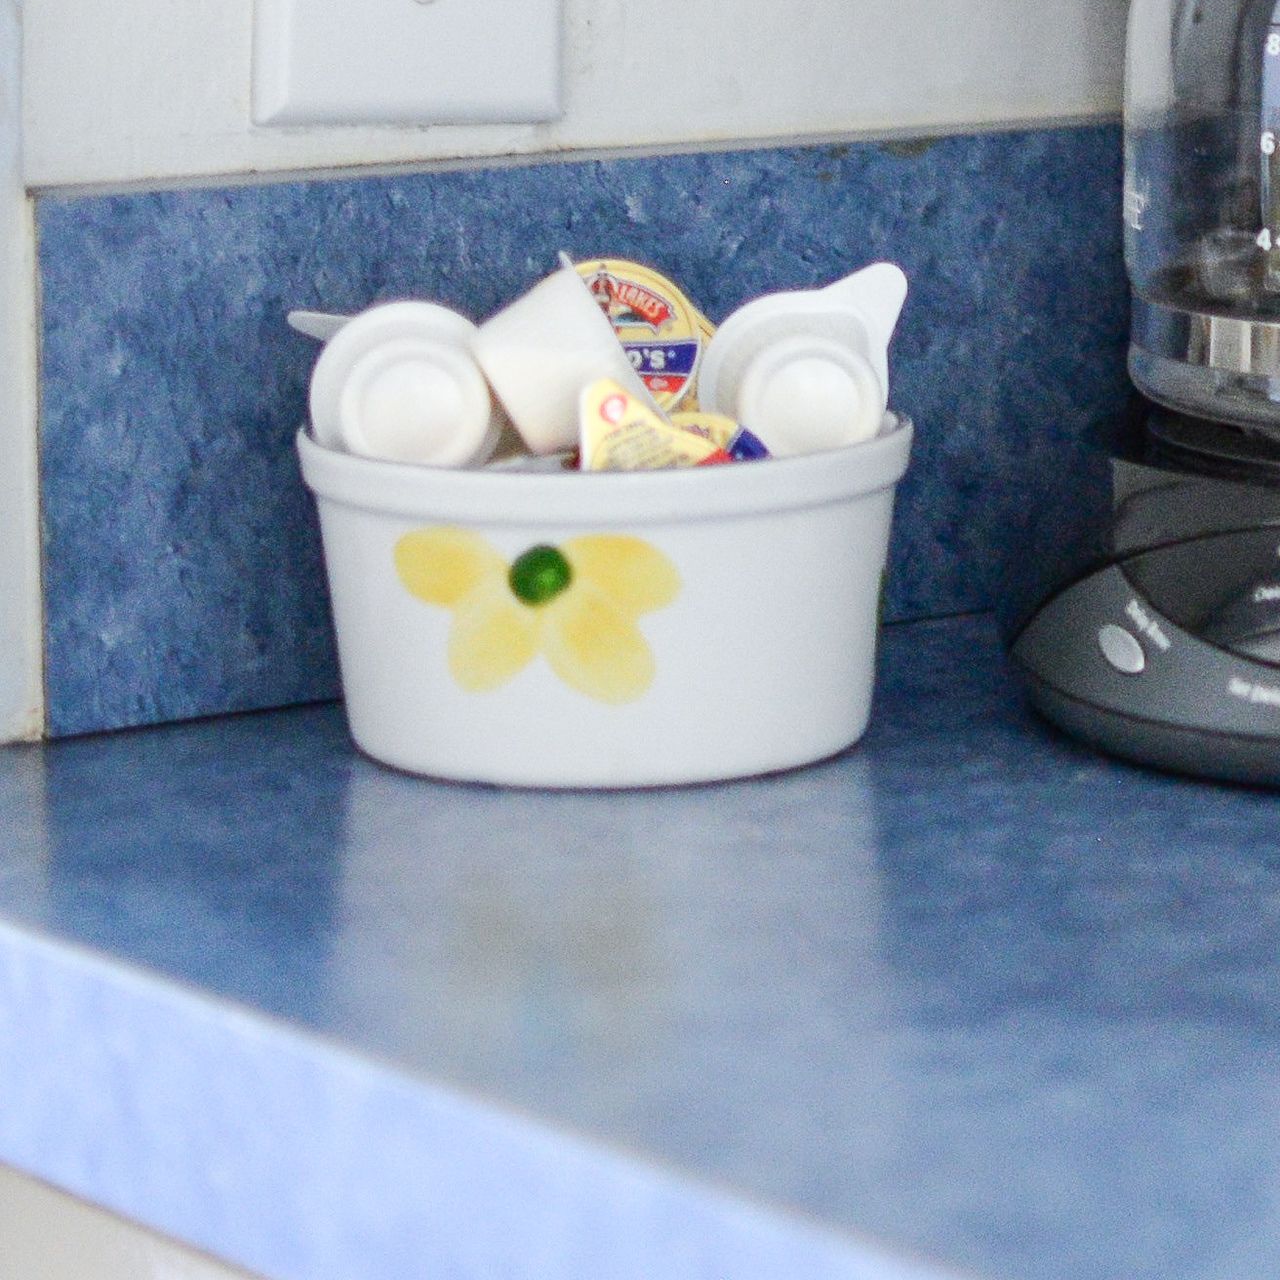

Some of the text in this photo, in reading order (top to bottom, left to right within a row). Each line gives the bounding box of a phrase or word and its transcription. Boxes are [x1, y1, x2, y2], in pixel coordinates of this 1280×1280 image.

[1266, 32, 1280, 57] 8
[1260, 133, 1275, 155] 6
[1256, 227, 1272, 251] 4
[617, 283, 664, 320] LAKES
